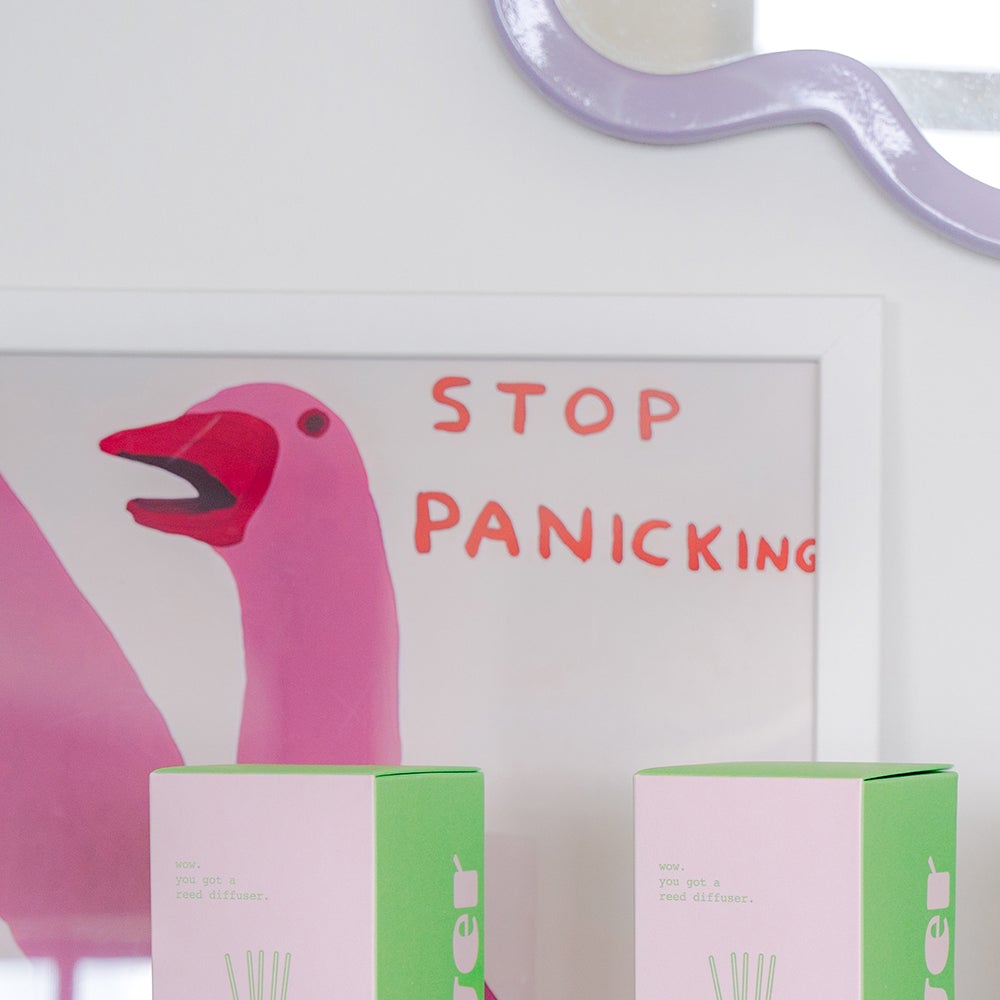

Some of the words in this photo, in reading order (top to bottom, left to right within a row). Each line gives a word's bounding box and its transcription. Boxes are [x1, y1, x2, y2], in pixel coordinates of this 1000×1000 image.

[432, 376, 680, 441] STOP
[414, 491, 816, 573] PANICKING
[175, 861, 201, 869] wow.
[658, 863, 685, 871] wow.
[175, 875, 196, 886] you
[202, 876, 222, 886] got
[658, 877, 679, 888] you
[686, 878, 707, 888] got
[176, 890, 202, 899] reed
[208, 890, 269, 900] diffuser.
[659, 892, 687, 901] reed
[693, 893, 753, 903] diffuser.
